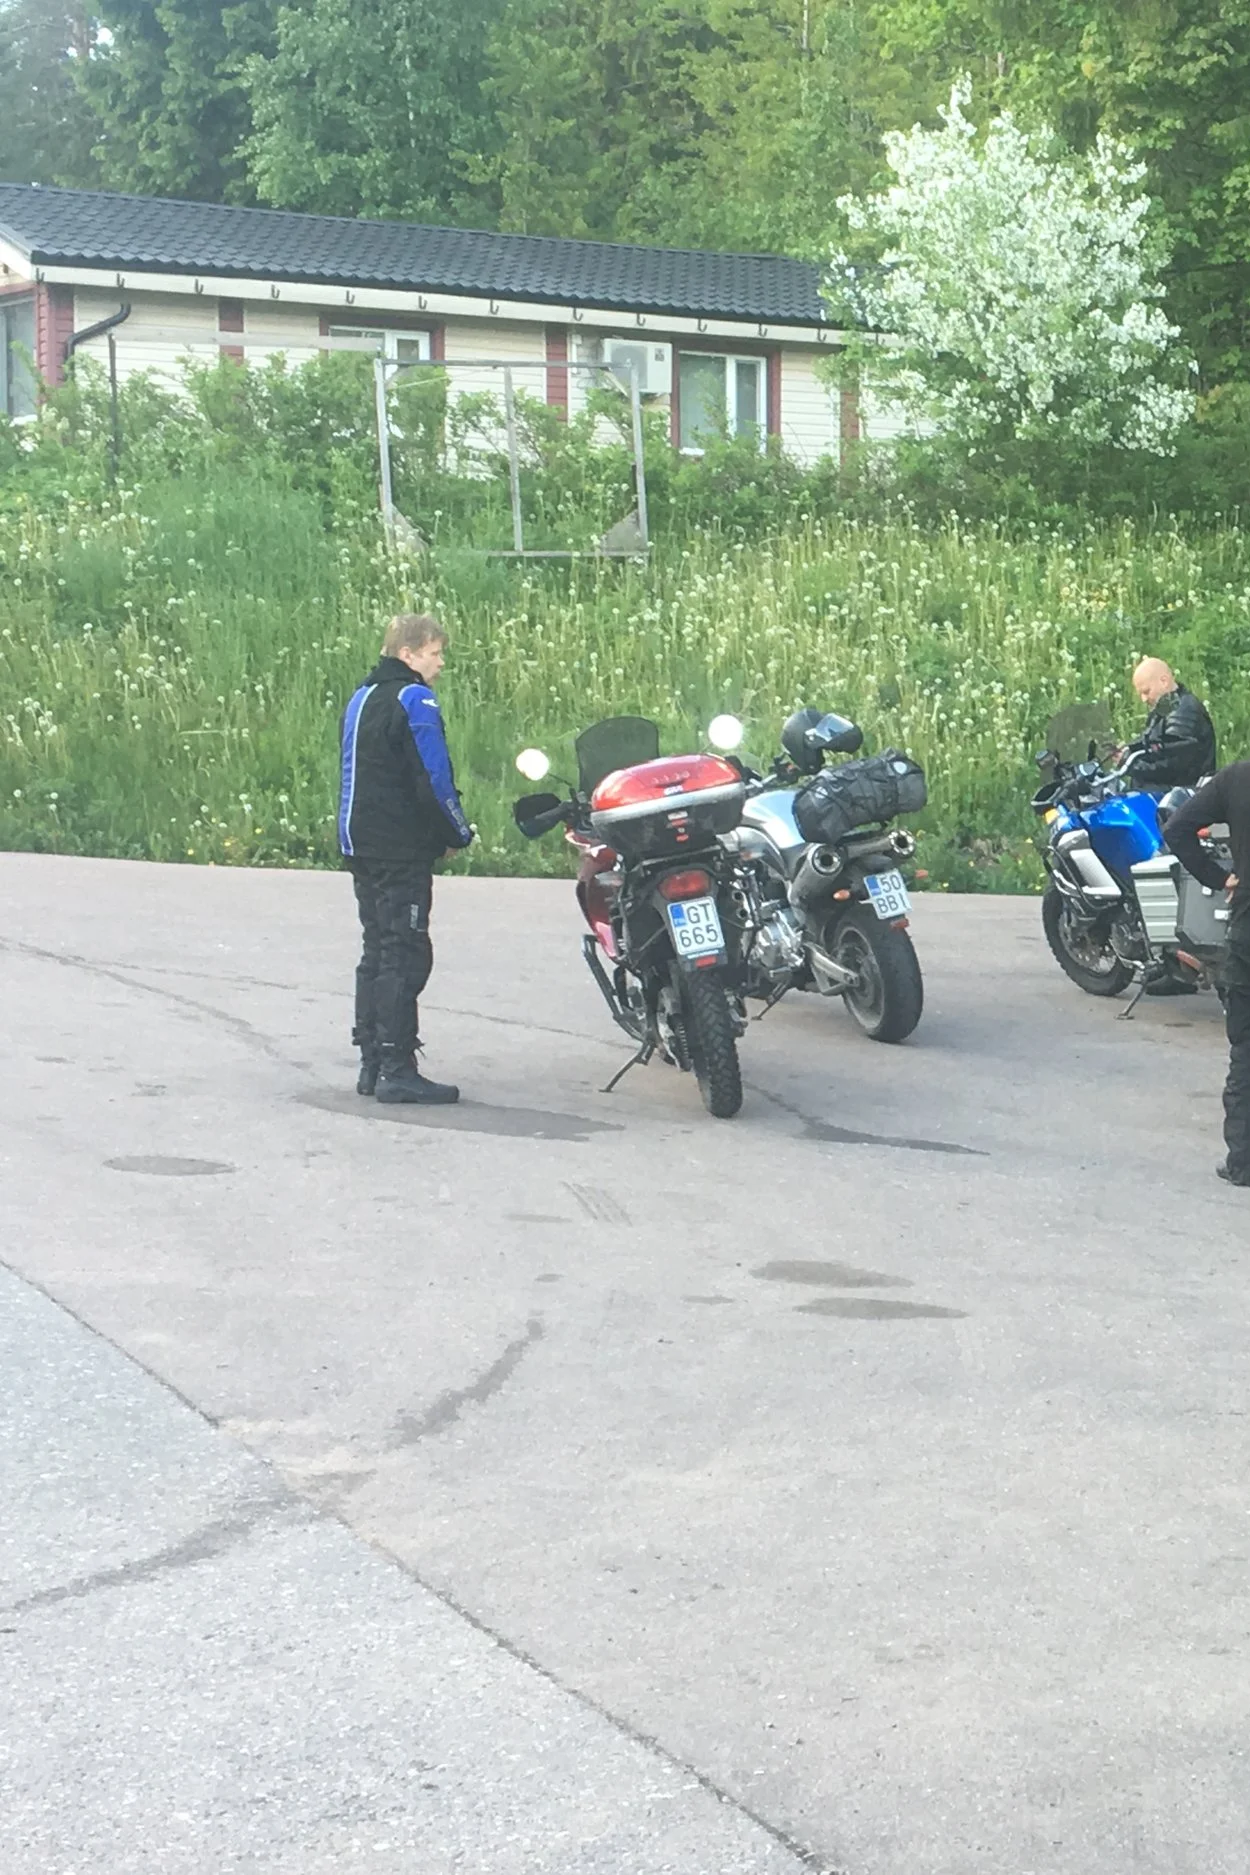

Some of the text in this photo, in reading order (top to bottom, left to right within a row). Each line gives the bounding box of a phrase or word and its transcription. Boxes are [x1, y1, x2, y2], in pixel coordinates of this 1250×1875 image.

[880, 874, 901, 893] 50
[686, 902, 711, 924] GT
[679, 923, 719, 948] 665
